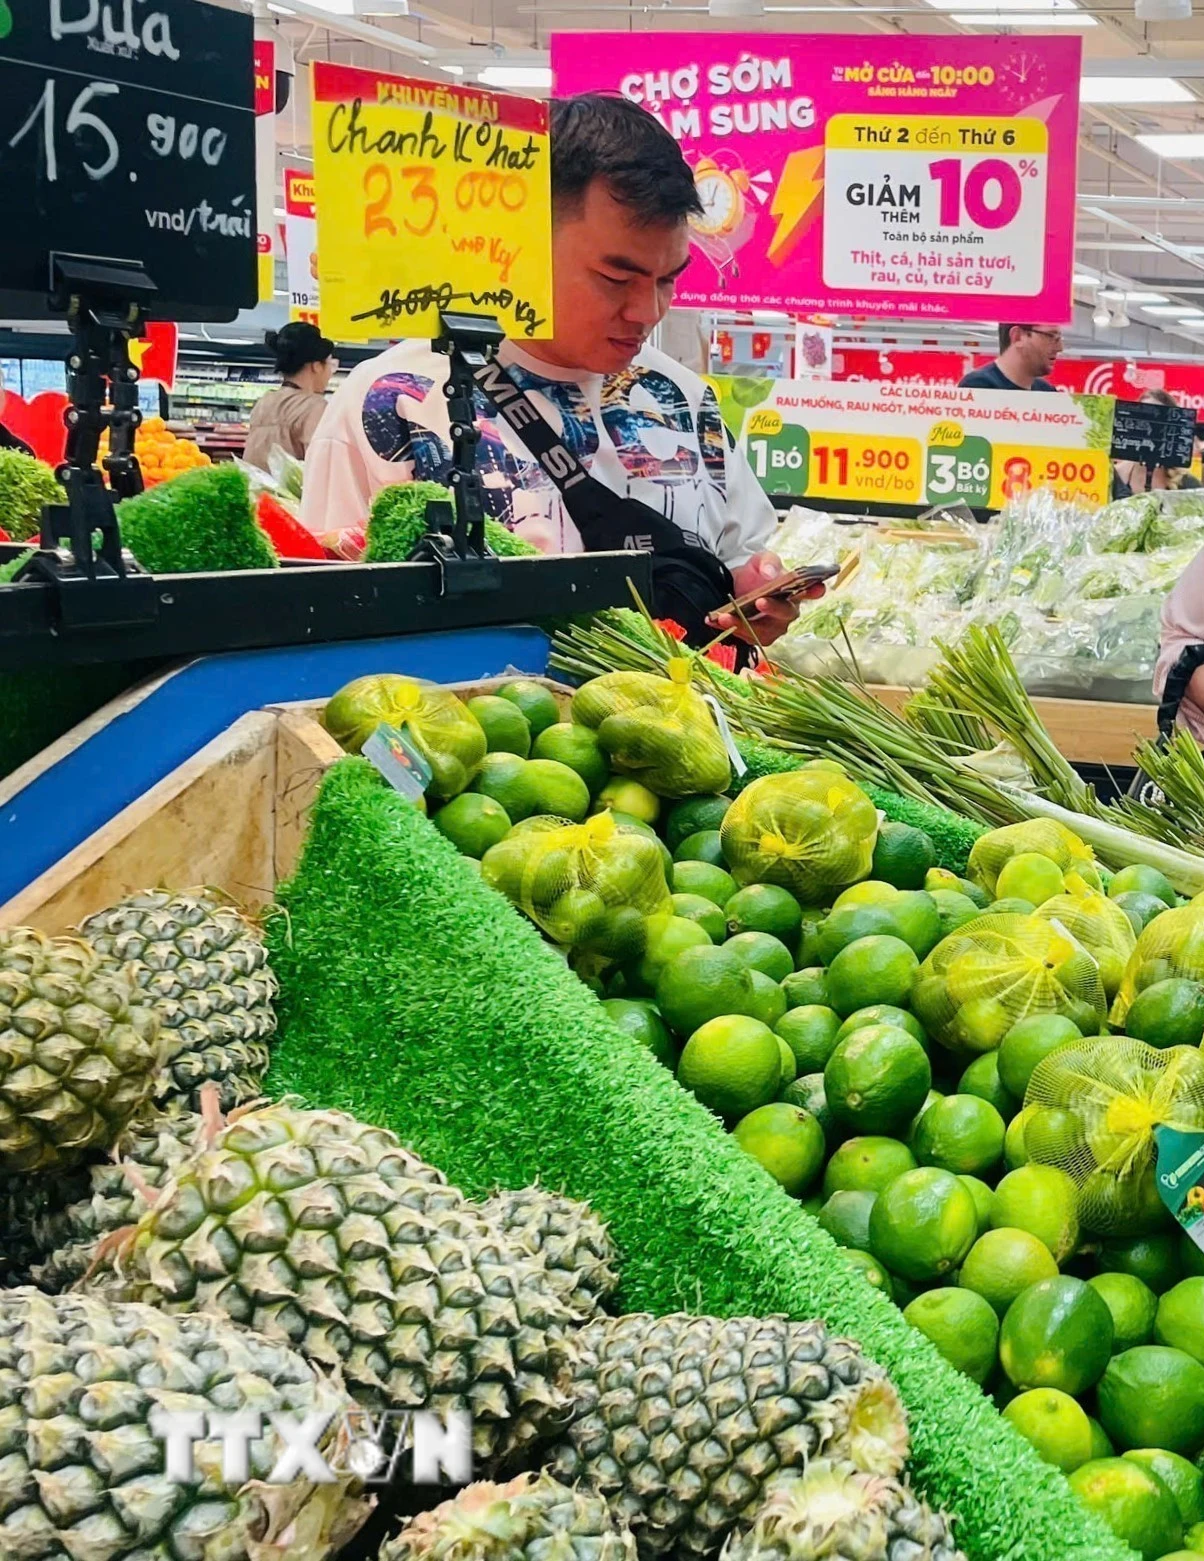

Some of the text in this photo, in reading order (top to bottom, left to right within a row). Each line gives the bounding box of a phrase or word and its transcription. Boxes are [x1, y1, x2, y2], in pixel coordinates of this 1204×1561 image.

[620, 53, 792, 105] CHỢ SỚM
[844, 61, 874, 83] MỞ
[877, 61, 915, 83] CỬA
[930, 66, 995, 86] 10:00
[376, 80, 499, 122] KHUYẾN MÃI
[710, 97, 815, 137] SUNG
[327, 97, 447, 160] Chanh
[854, 126, 1016, 146] Thứ 2 đến Thứ 6
[846, 174, 921, 207] GIẢM
[881, 209, 920, 223] THÊM
[912, 231, 927, 243] bộ
[930, 231, 949, 243] sản
[952, 231, 984, 246] phẩm
[850, 250, 1016, 272] Thịt, cá, hải sản tươi,
[871, 268, 993, 290] rau, củ, trái cây
[934, 389, 957, 401] RAU
[776, 397, 799, 407] RAU
[847, 401, 870, 411] RAU
[968, 408, 991, 420] RAU
[750, 413, 780, 430] Mua
[930, 425, 962, 442] Mua
[750, 439, 768, 478] 1
[771, 446, 803, 470] BÓ
[928, 454, 957, 494] 3
[957, 458, 990, 482] BÓ
[956, 483, 974, 495] Bất
